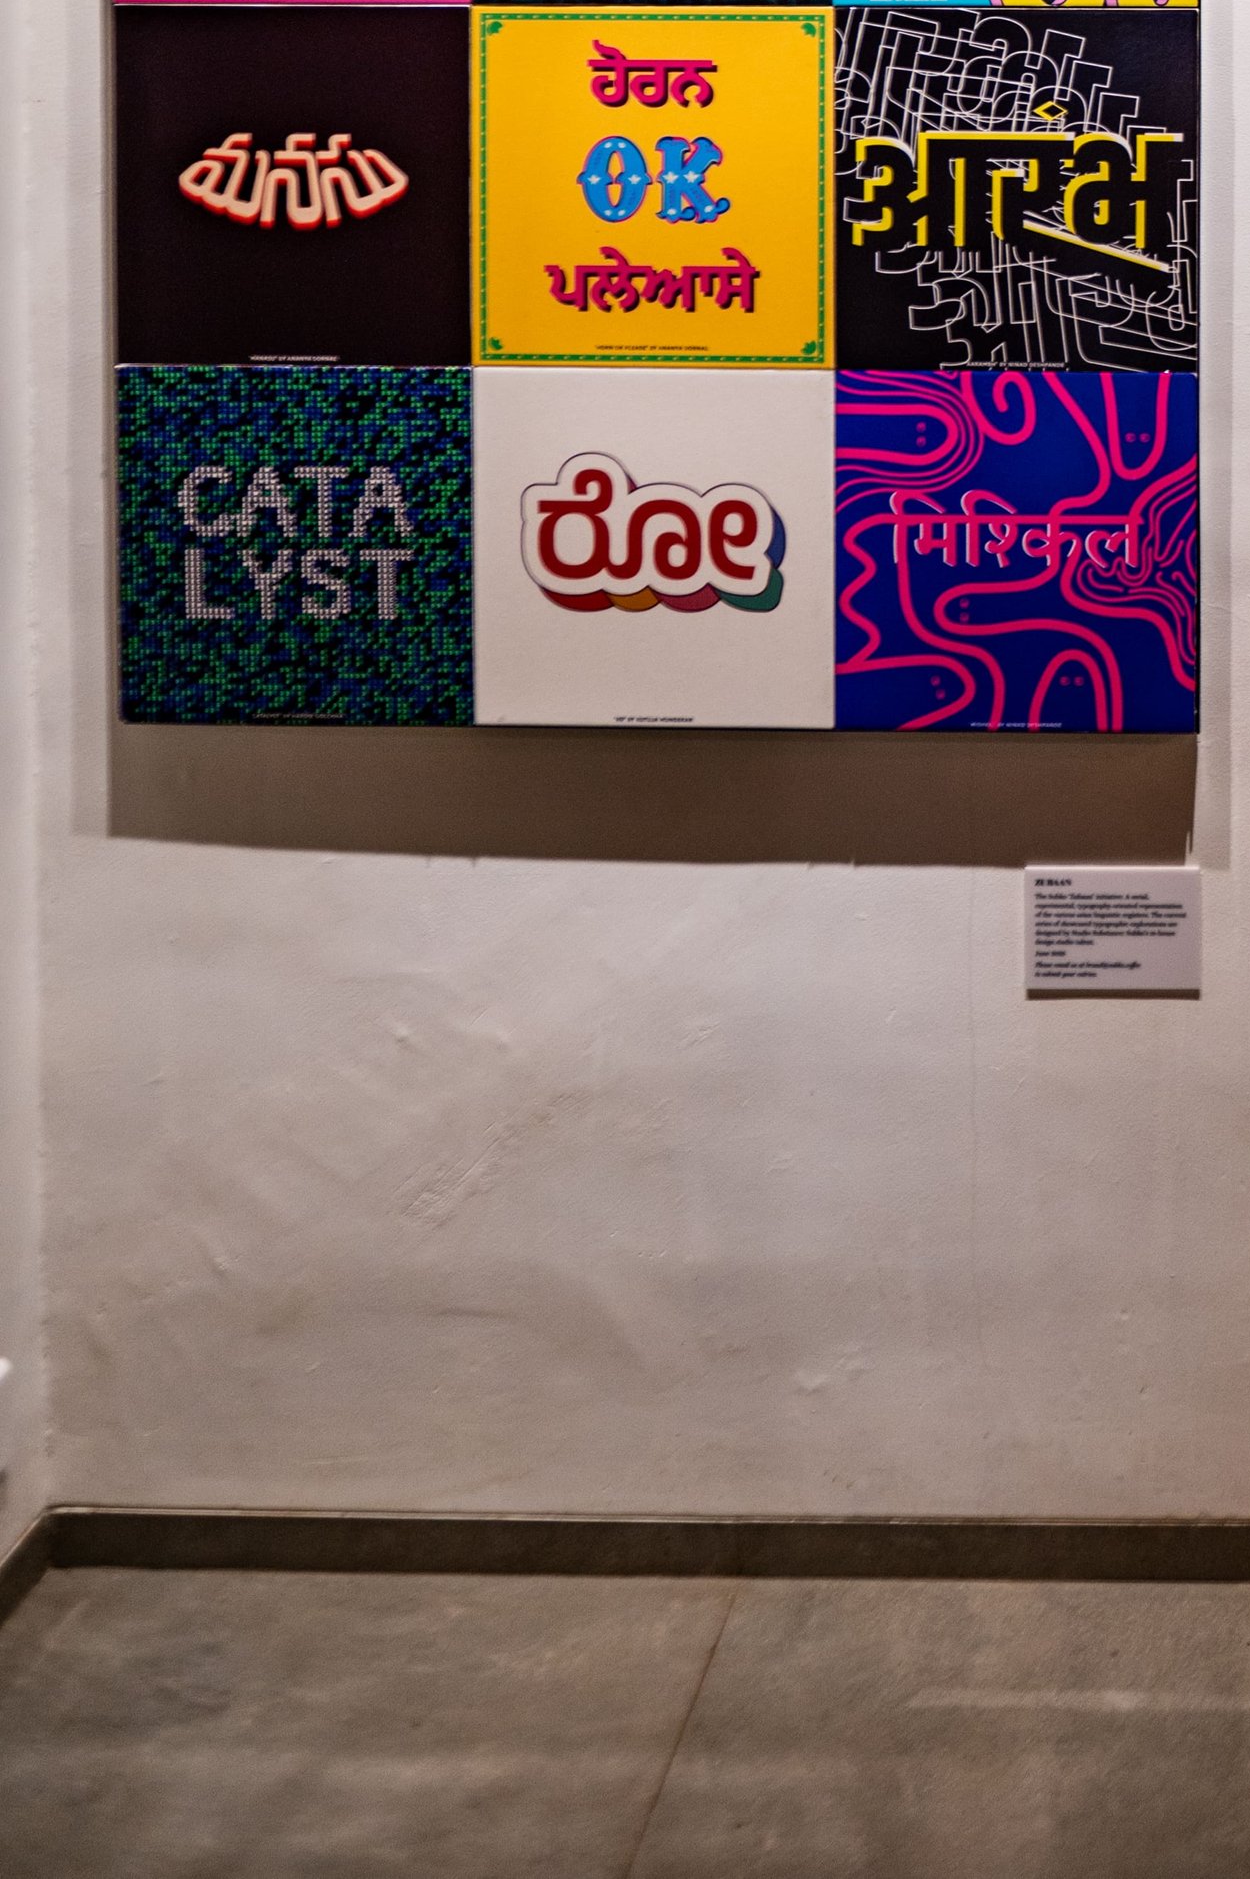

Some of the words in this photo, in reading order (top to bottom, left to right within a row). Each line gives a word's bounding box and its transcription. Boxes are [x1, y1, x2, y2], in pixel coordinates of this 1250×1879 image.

[576, 136, 731, 223] OK
[177, 465, 415, 538] CATA
[184, 548, 416, 620] LYST
